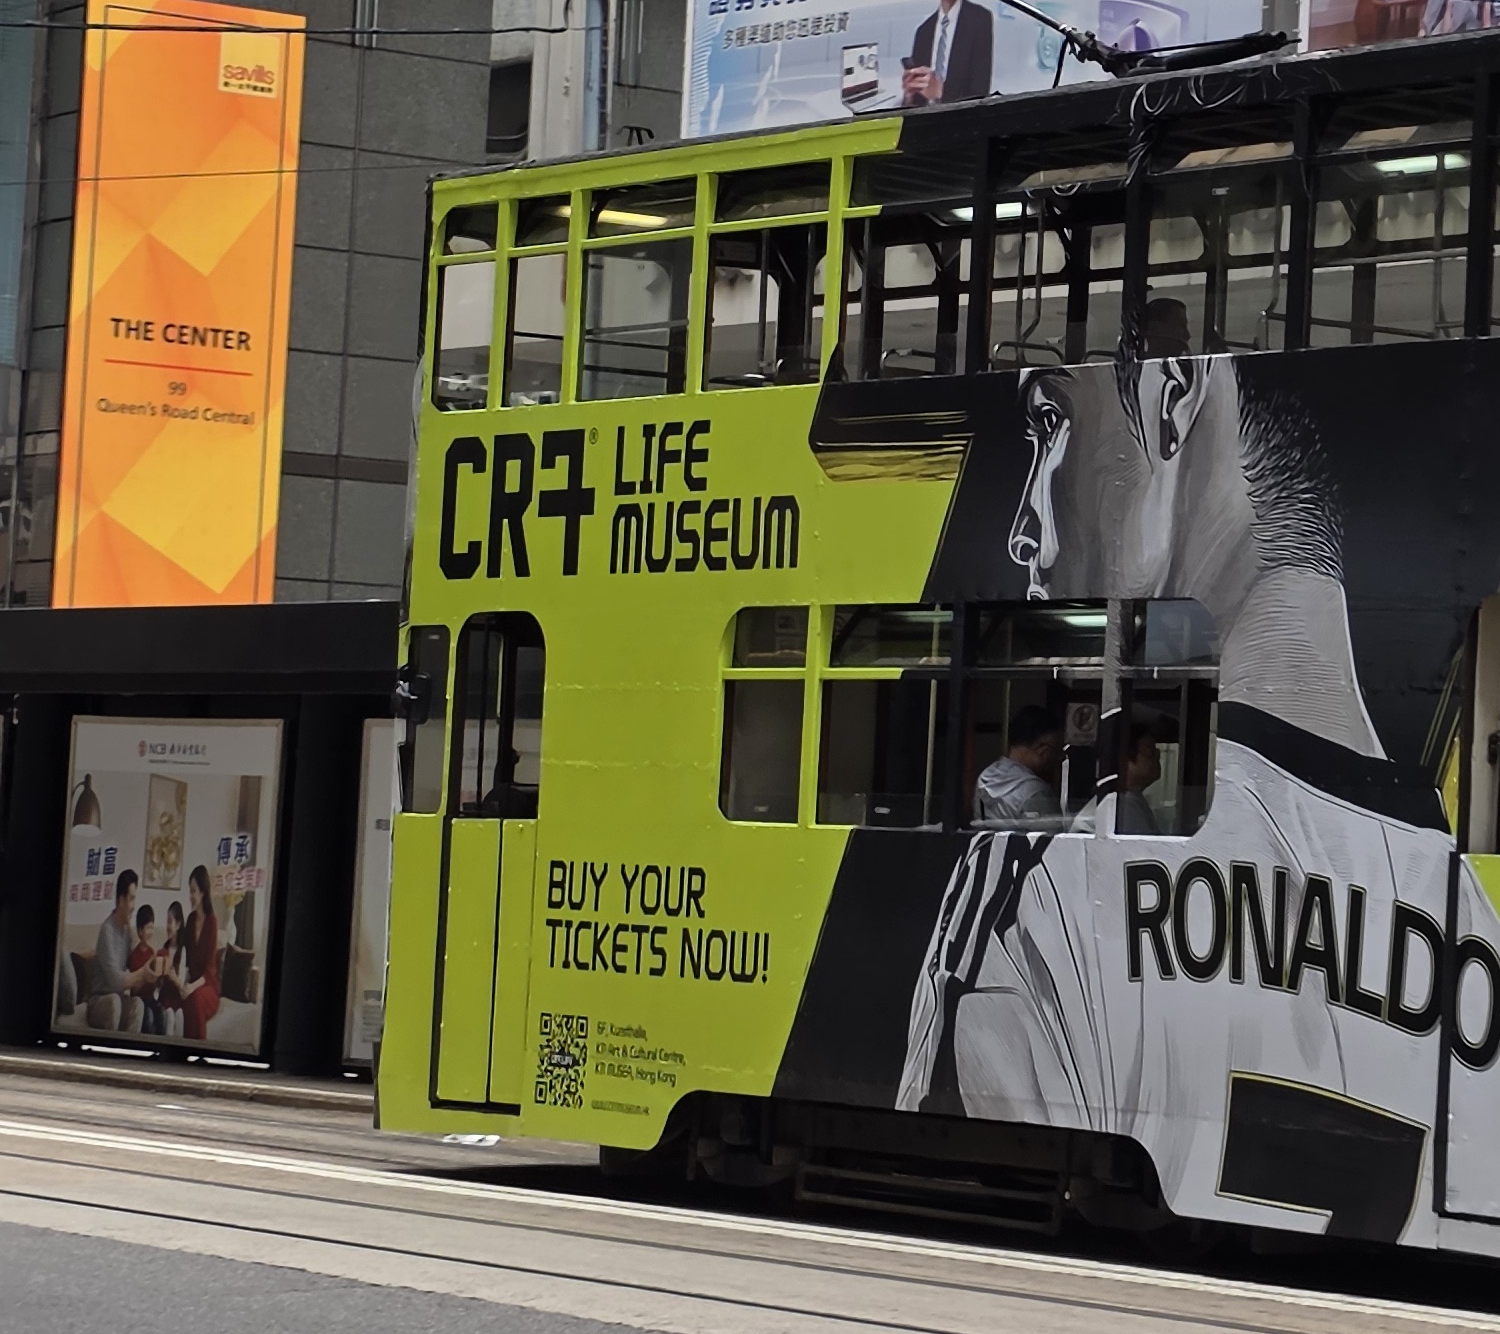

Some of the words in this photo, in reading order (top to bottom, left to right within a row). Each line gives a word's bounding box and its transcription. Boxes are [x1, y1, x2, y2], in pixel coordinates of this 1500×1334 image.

[110, 317, 155, 341] THE
[163, 323, 251, 352] CENTER
[97, 398, 157, 418] Queen's
[162, 404, 198, 422] Road
[202, 407, 255, 427] Central
[168, 381, 187, 397] 99
[614, 419, 711, 496] LIFE
[609, 495, 800, 575] MUSEUM
[548, 860, 609, 912] BUY
[620, 863, 706, 919] YOUR
[545, 918, 668, 978] TICKETS
[679, 928, 771, 984] NOW!
